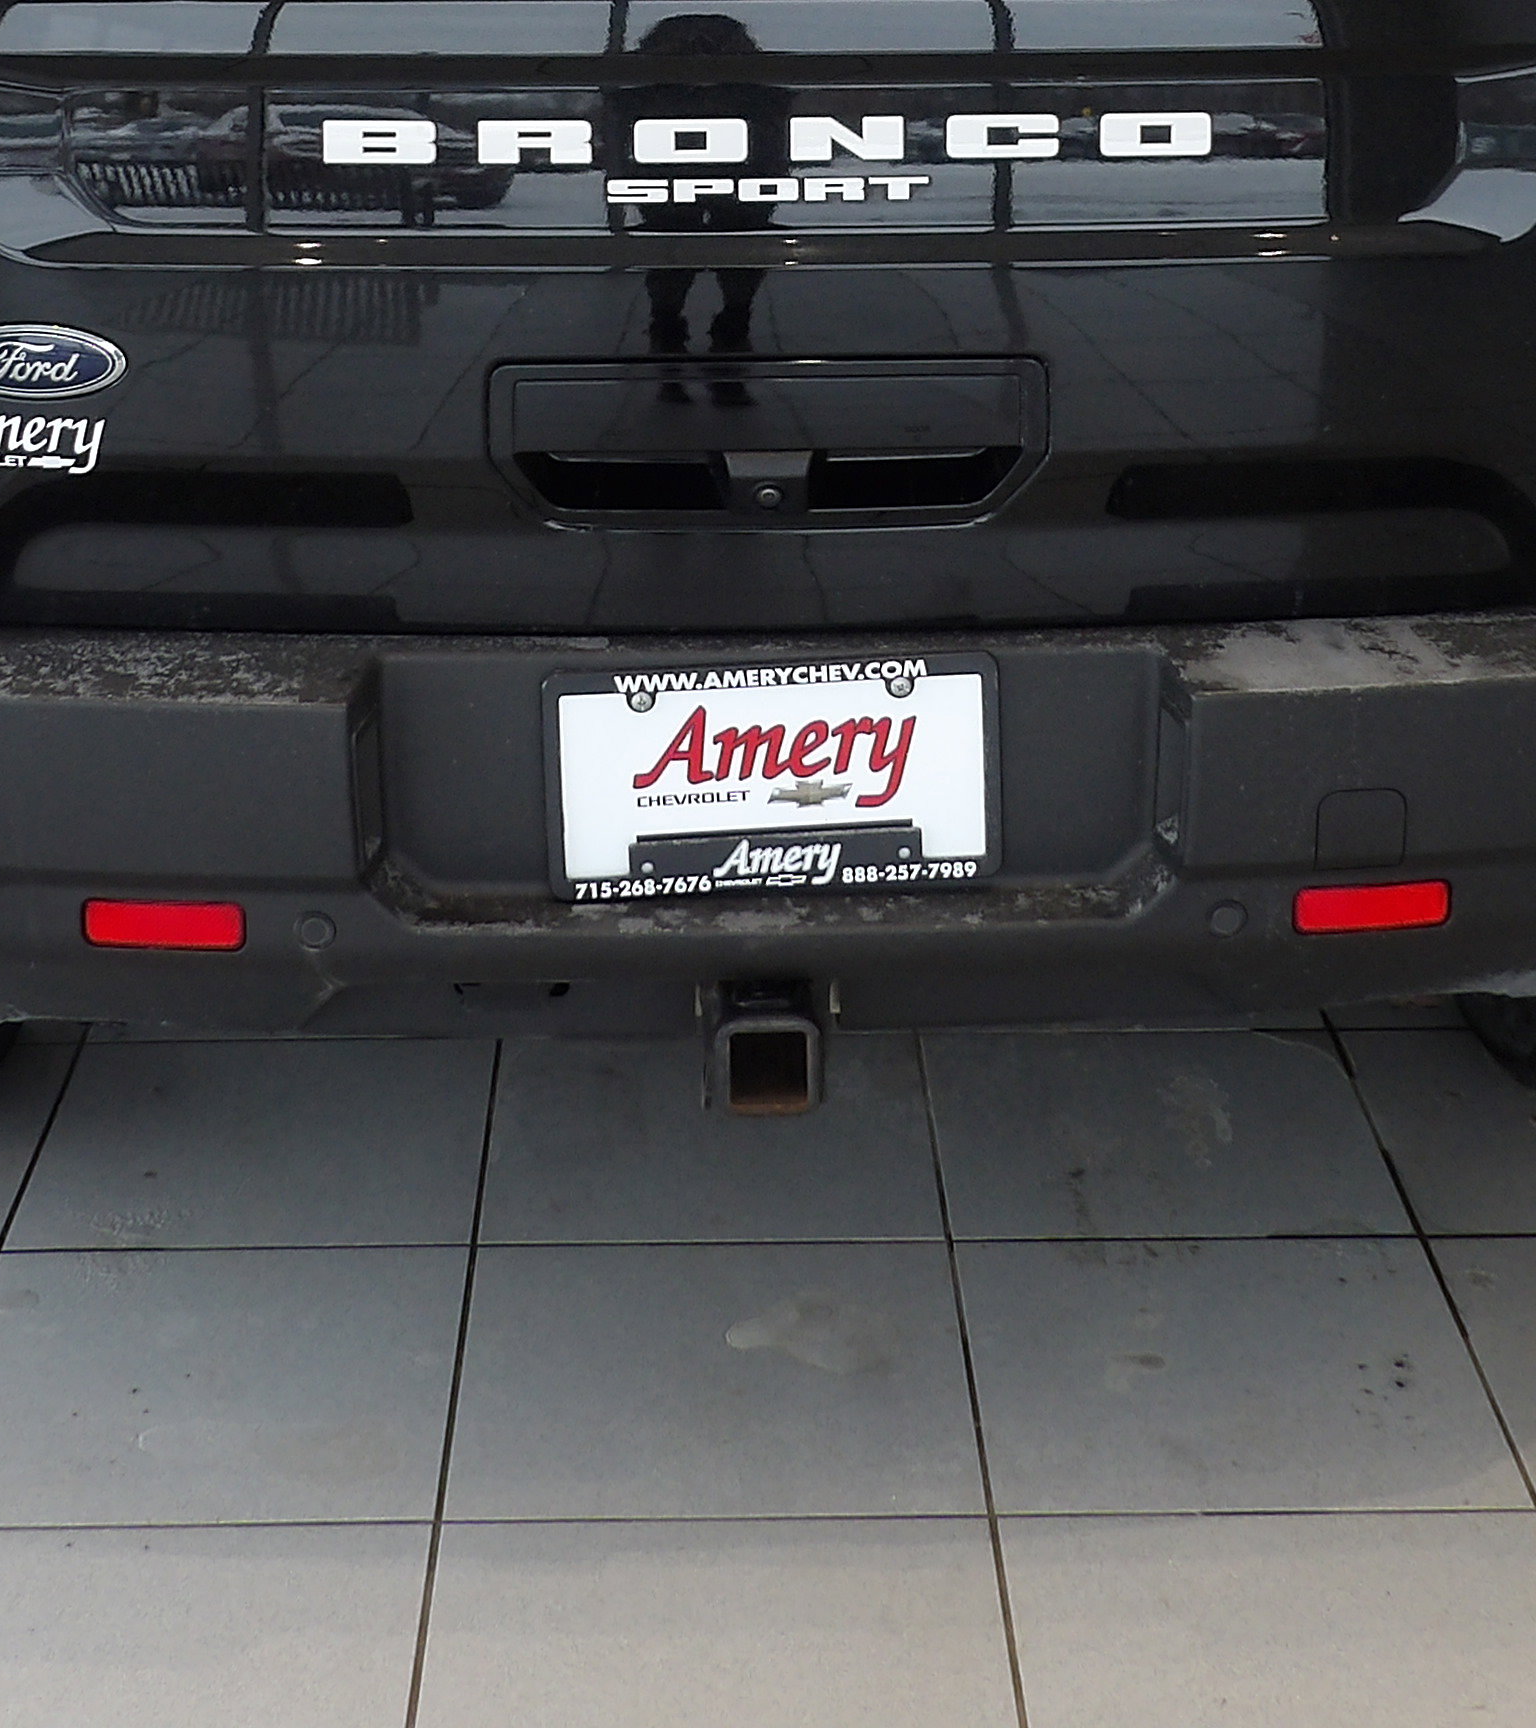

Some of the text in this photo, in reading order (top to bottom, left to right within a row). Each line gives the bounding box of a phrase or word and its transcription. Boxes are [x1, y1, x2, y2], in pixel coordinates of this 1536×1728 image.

[321, 112, 1212, 165] BRONCO
[606, 176, 930, 203] SPORT
[614, 659, 927, 693] WWW.AMERYCHEV.COM
[632, 705, 916, 807] Amery
[636, 790, 751, 807] CHEVROLET
[713, 839, 841, 885] Amery
[841, 862, 977, 884] 888-257-7989
[575, 875, 712, 900] 715-268-7676
